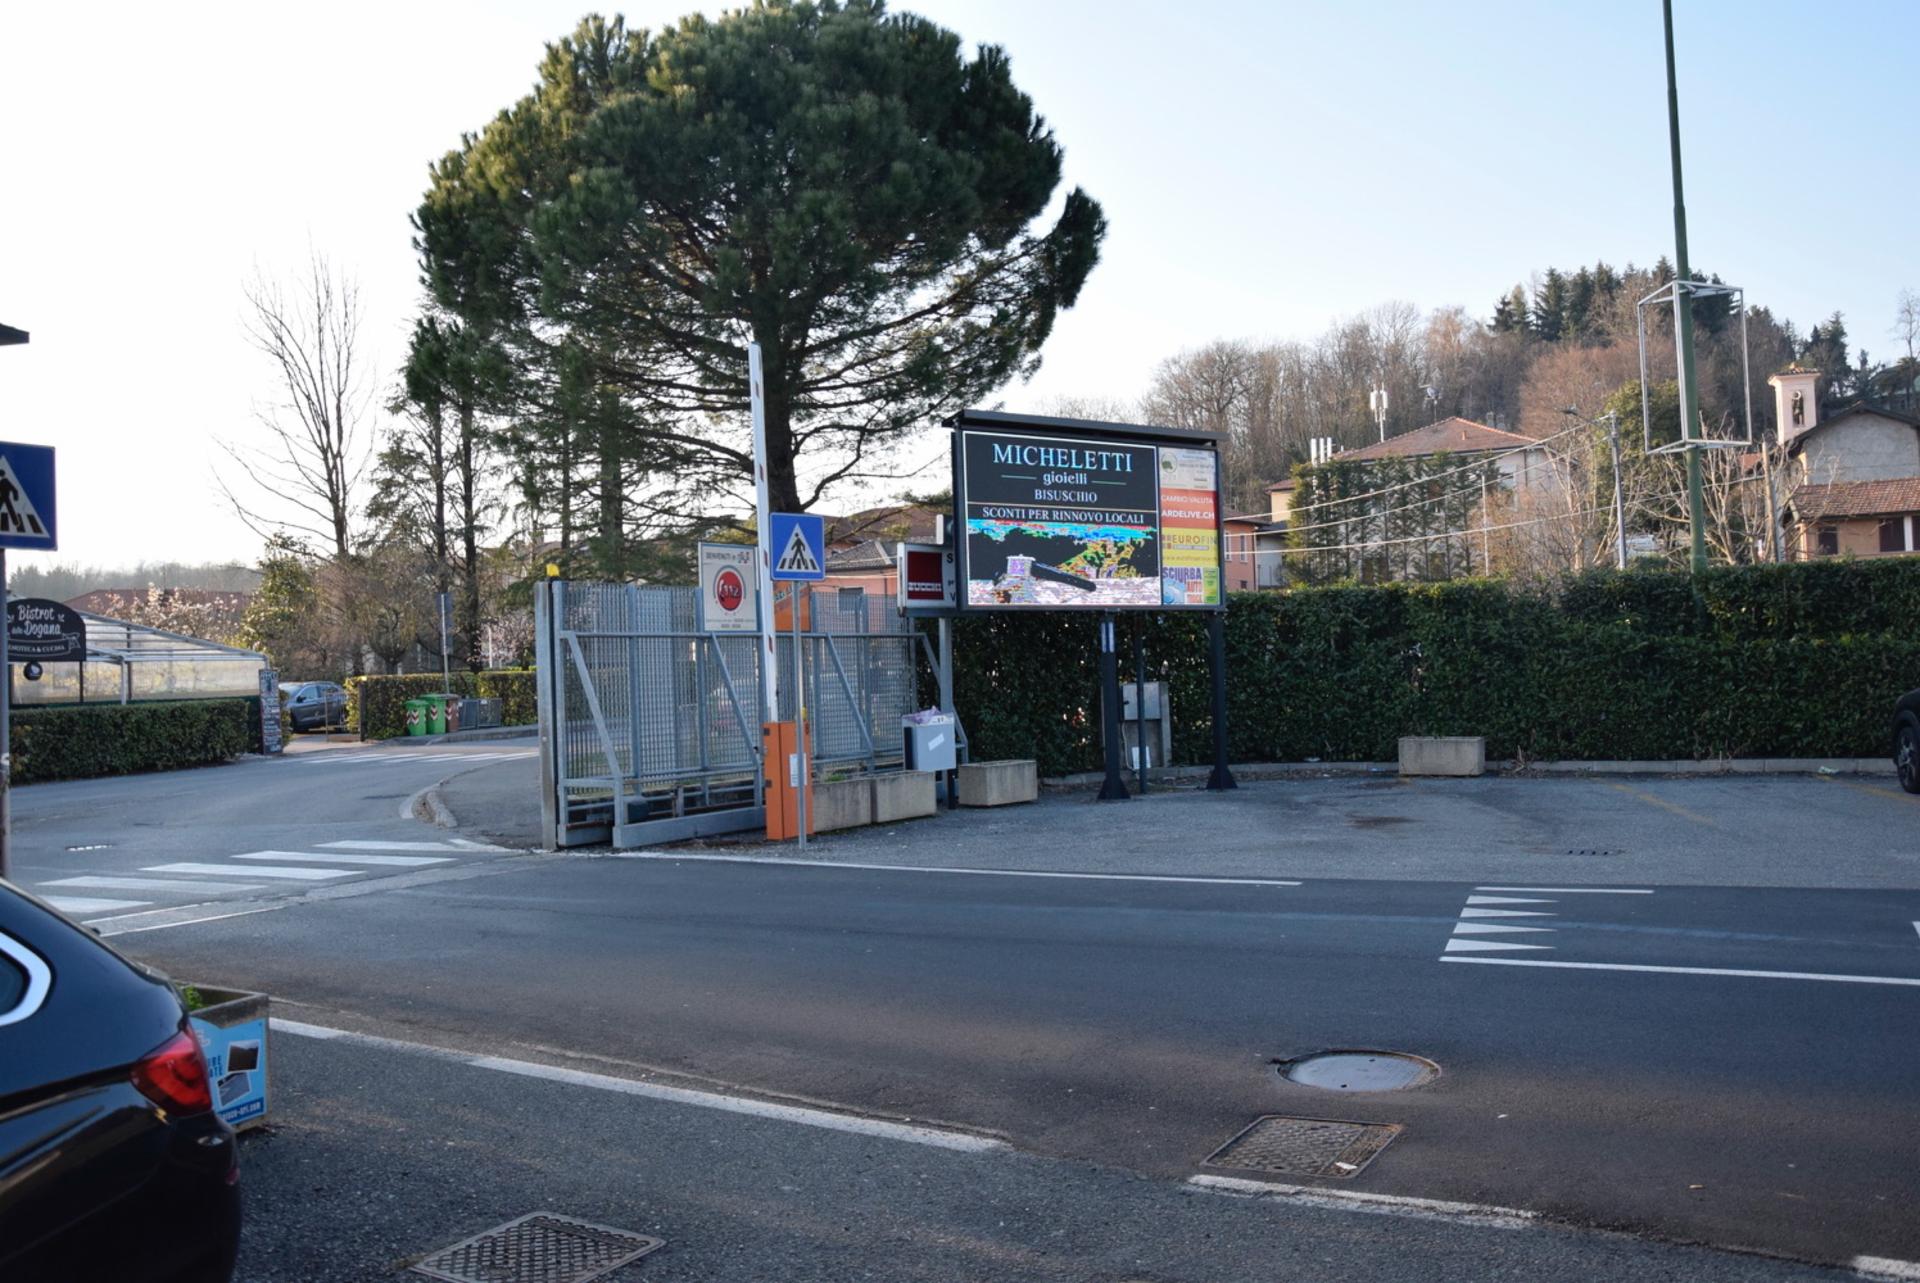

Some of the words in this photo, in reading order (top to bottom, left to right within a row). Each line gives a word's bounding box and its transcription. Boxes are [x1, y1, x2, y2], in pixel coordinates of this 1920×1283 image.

[992, 443, 1133, 472] MICHELETTI
[1043, 471, 1087, 486] gioielli
[1034, 489, 1098, 503] BISUSCHIO
[982, 506, 1025, 519] SCONTI
[1028, 508, 1050, 520] PER
[1053, 511, 1103, 522] RINNOVO
[1105, 513, 1145, 524] LOCALI
[1163, 567, 1202, 584] SCIURBA
[17, 604, 55, 620] Bistrot
[24, 620, 61, 638] Dogana
